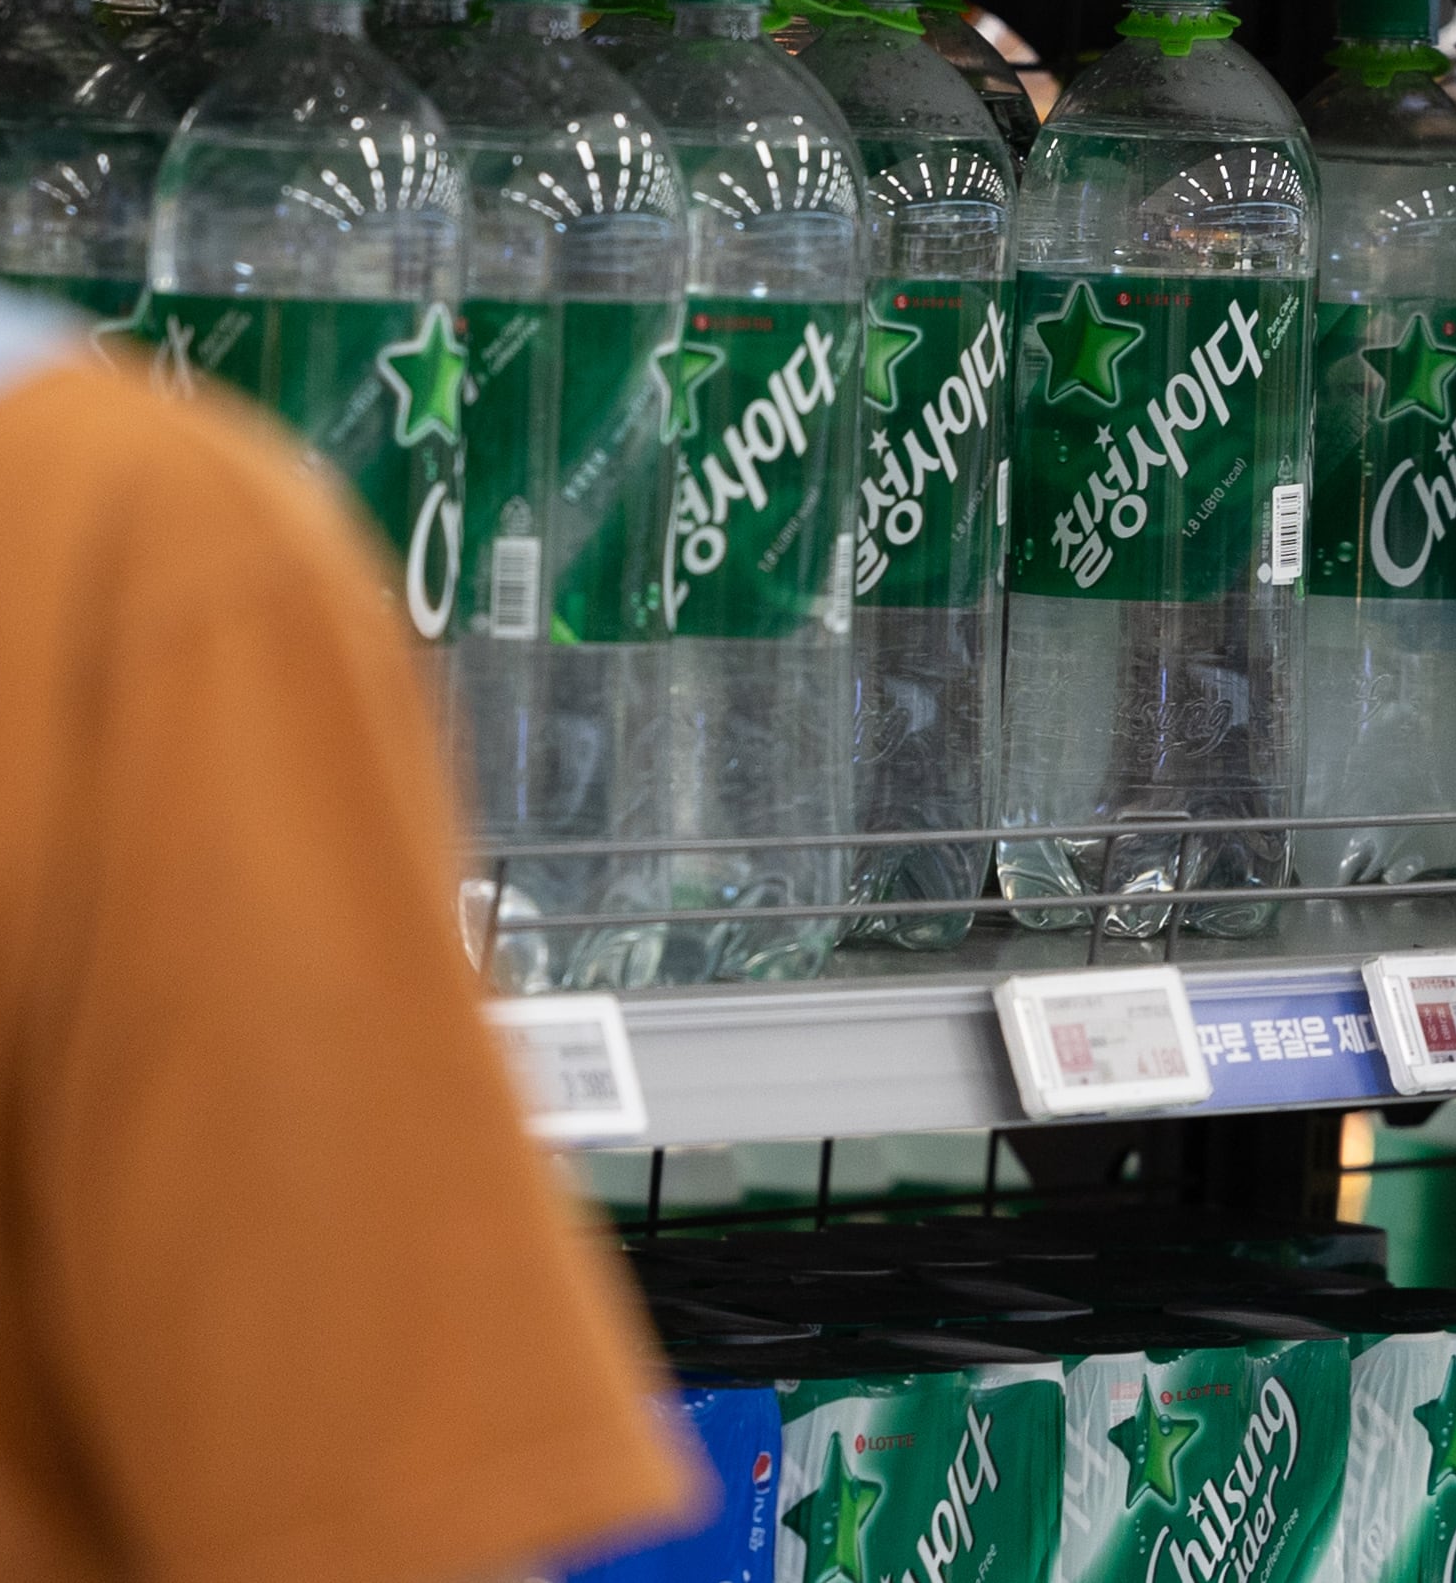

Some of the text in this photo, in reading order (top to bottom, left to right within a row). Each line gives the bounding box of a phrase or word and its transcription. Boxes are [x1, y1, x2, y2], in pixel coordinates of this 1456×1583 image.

[677, 320, 836, 575] 성사이다
[1051, 298, 1263, 589] 칠성사이다
[1181, 457, 1248, 539] 1.8 L(810 kcal)
[1197, 1021, 1252, 1066] 꾸로
[1250, 1016, 1334, 1061] 품질은
[1176, 1383, 1233, 1401] LOTTE
[868, 1434, 915, 1451] LOTTE
[1217, 1465, 1279, 1583] ider
